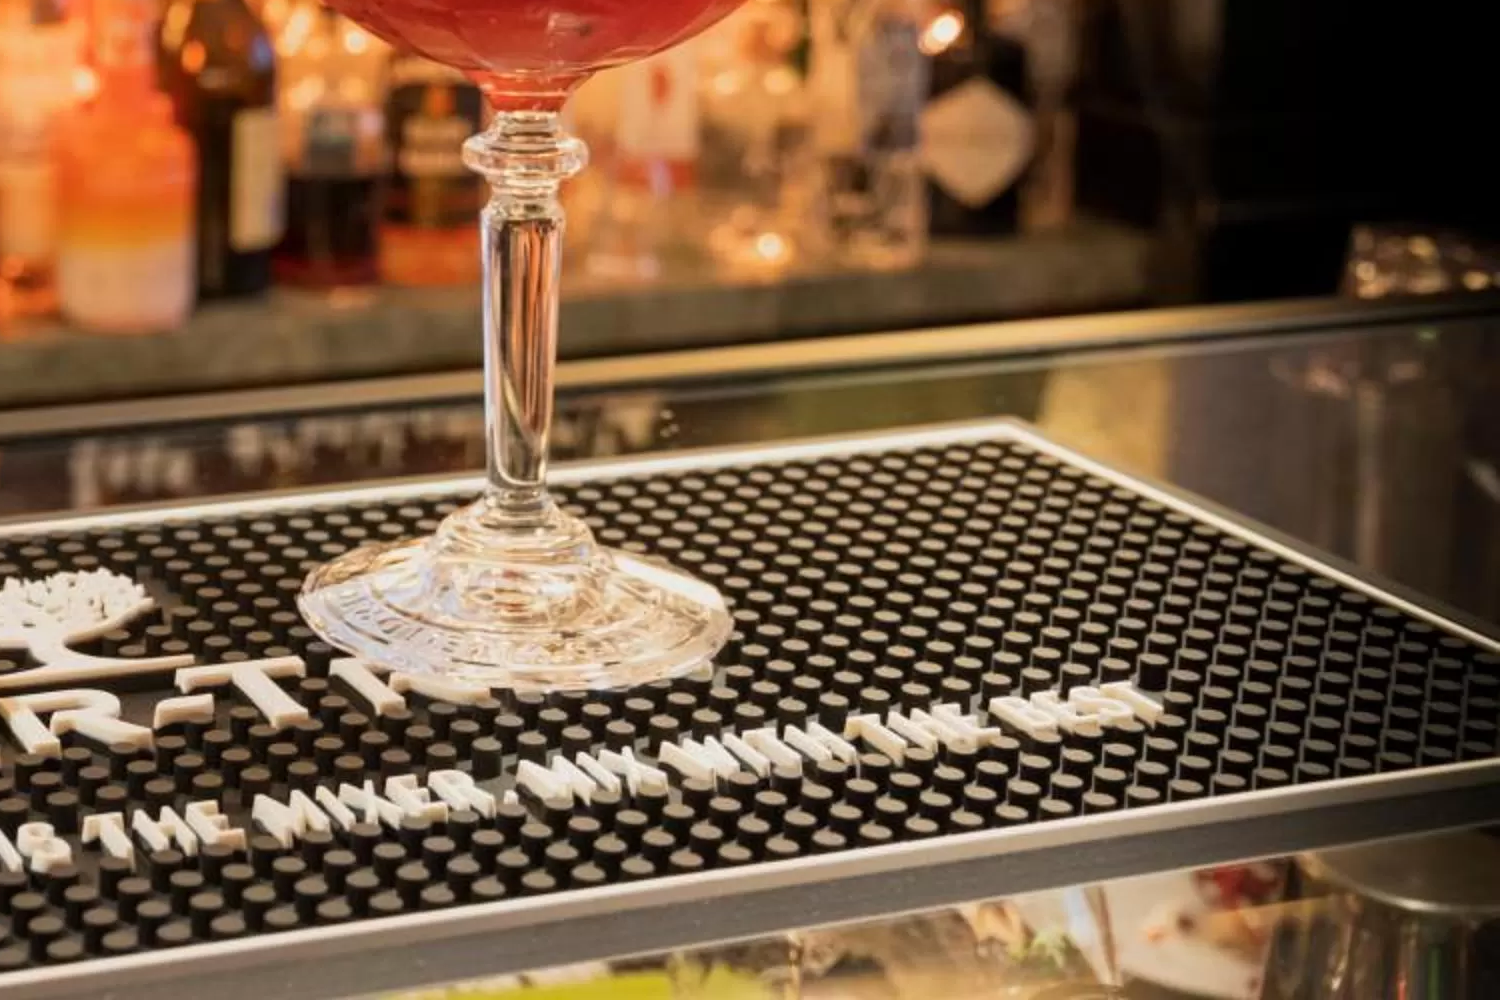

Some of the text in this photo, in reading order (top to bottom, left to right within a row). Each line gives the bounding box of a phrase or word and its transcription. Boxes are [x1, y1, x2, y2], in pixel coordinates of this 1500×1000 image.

[81, 799, 247, 873] THE
[516, 745, 669, 806] MIX
[657, 720, 858, 782] WITH
[843, 703, 1002, 765] THE
[988, 680, 1165, 734] BEST
